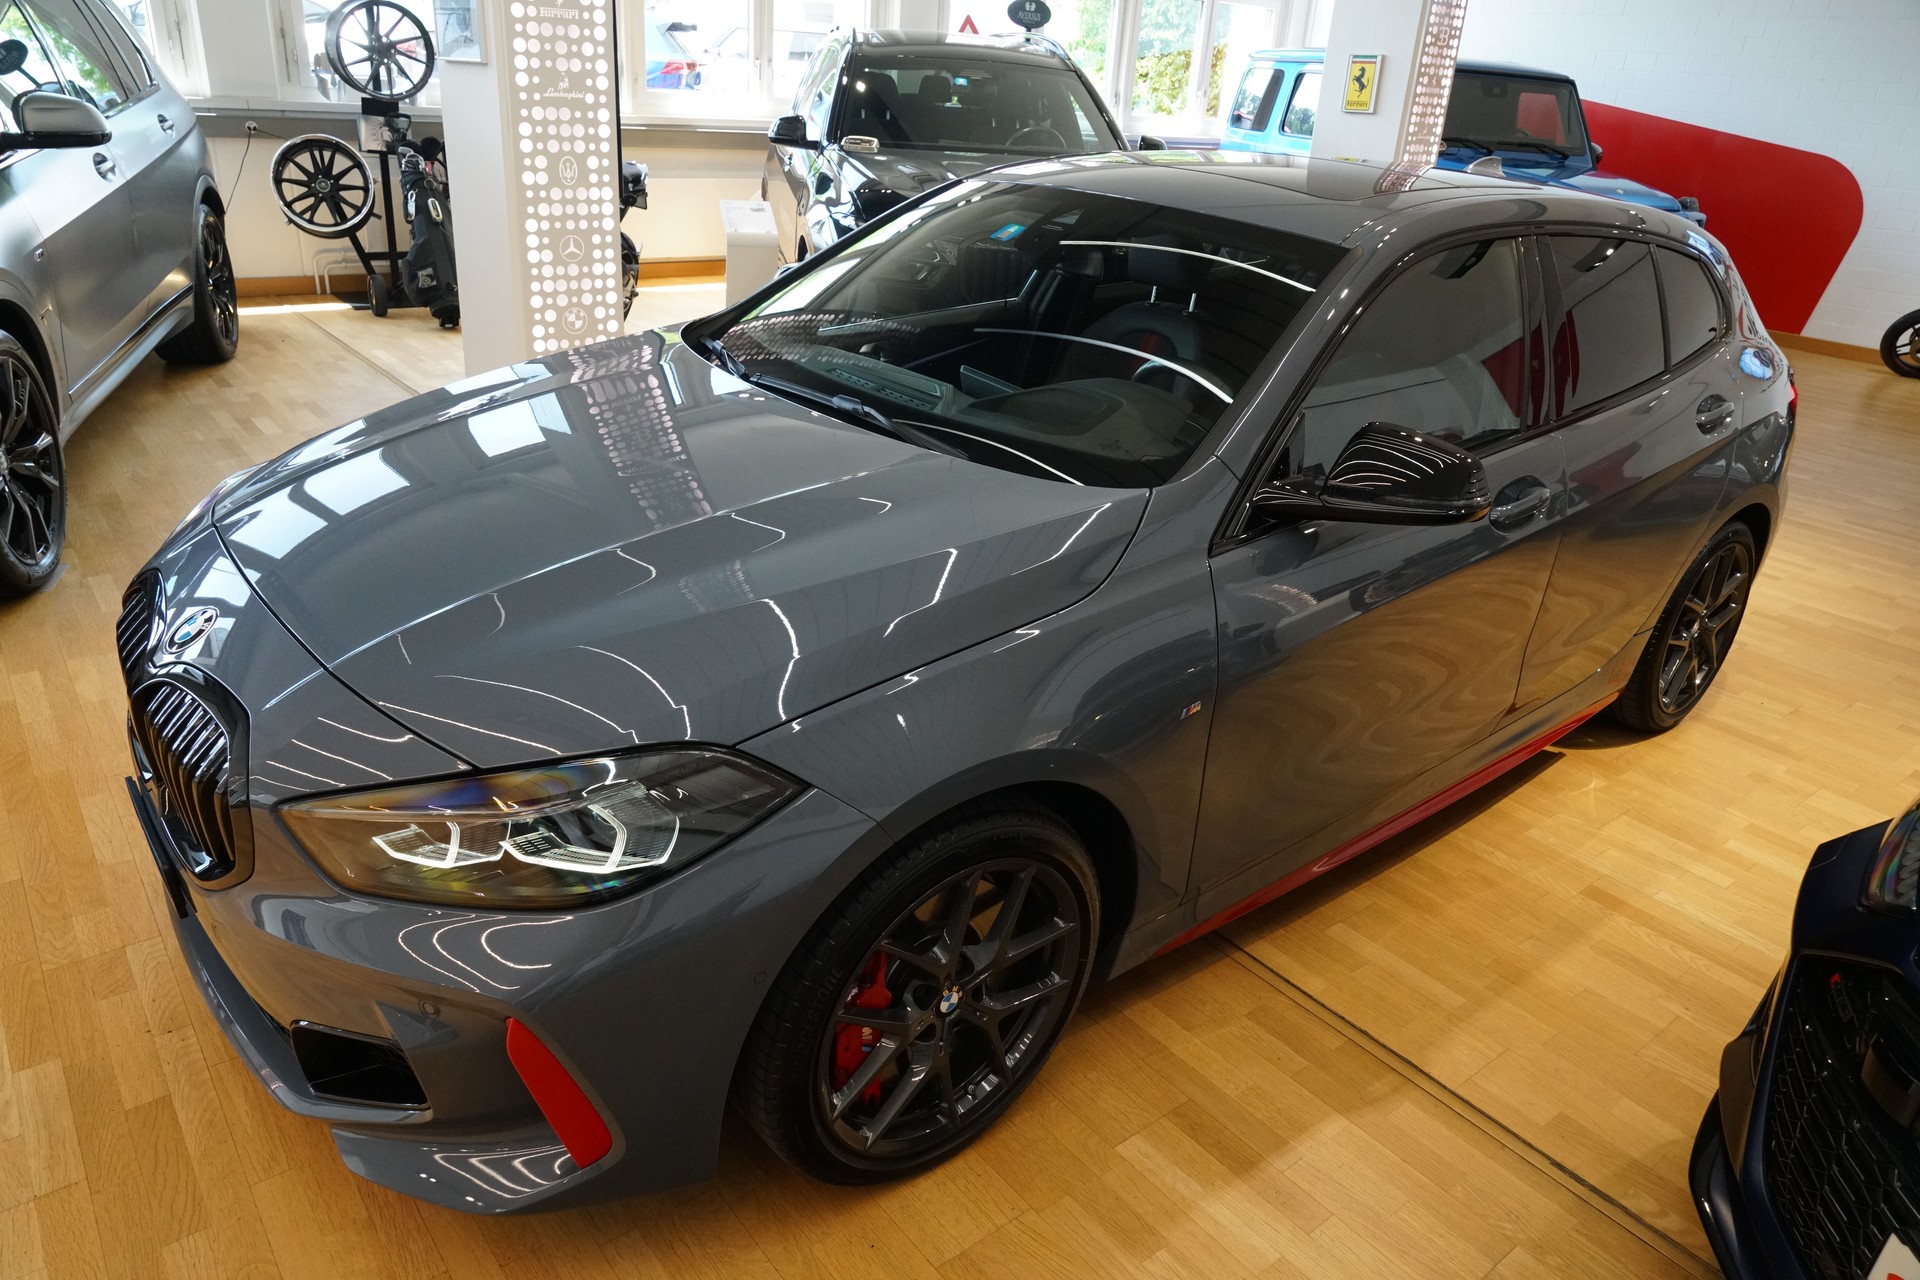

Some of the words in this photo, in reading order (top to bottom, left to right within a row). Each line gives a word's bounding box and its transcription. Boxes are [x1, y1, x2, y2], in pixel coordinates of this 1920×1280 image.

[539, 7, 579, 19] Ferrari
[1017, 11, 1041, 21] AVERSUS
[543, 87, 585, 100] Lamborghini
[1347, 100, 1368, 108] Ferrari
